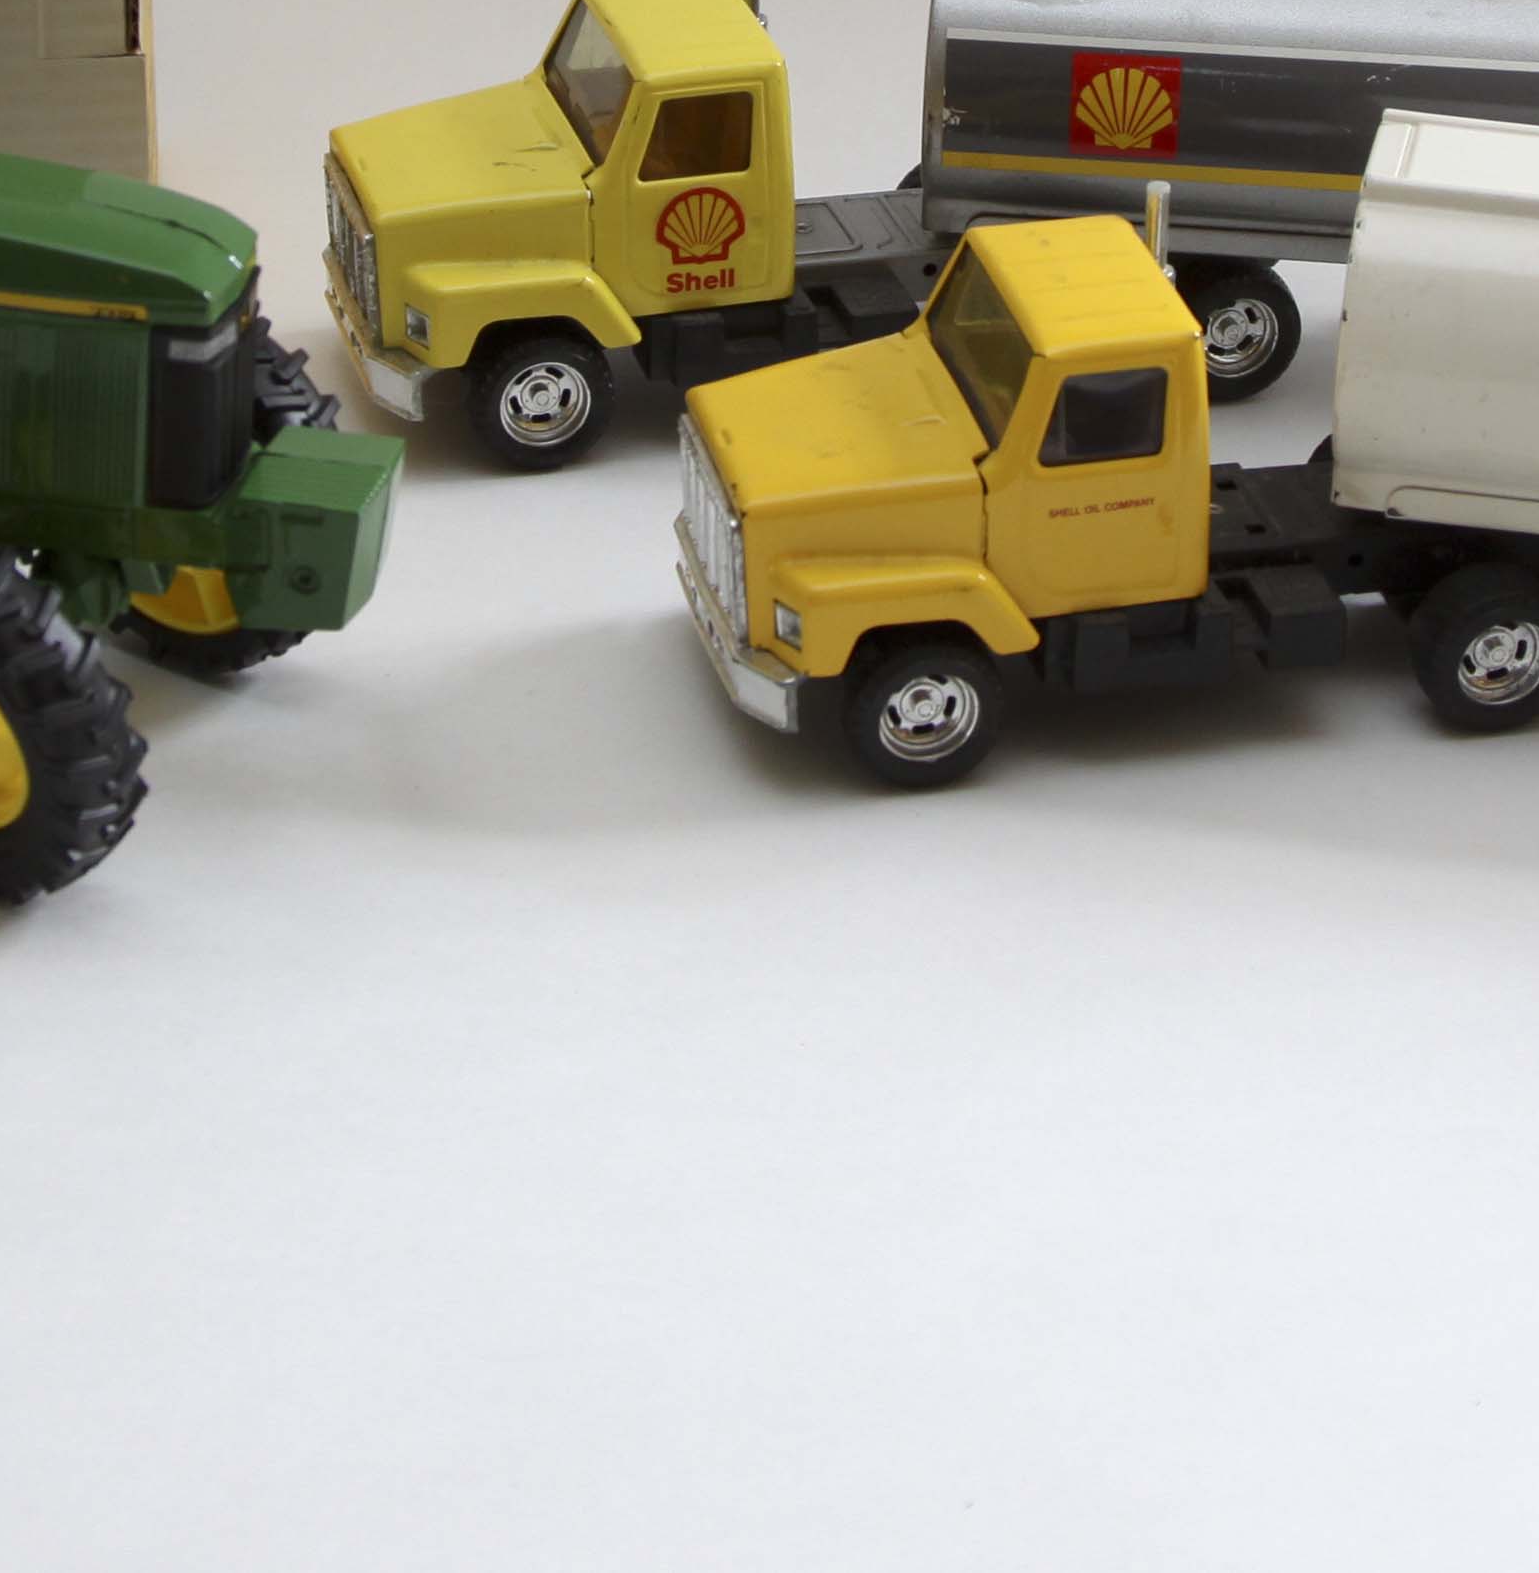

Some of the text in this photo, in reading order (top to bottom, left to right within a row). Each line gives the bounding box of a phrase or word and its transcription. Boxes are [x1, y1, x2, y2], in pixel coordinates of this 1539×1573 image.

[666, 268, 735, 294] Shell
[1049, 498, 1156, 517] SHELL OIL COMPANY
